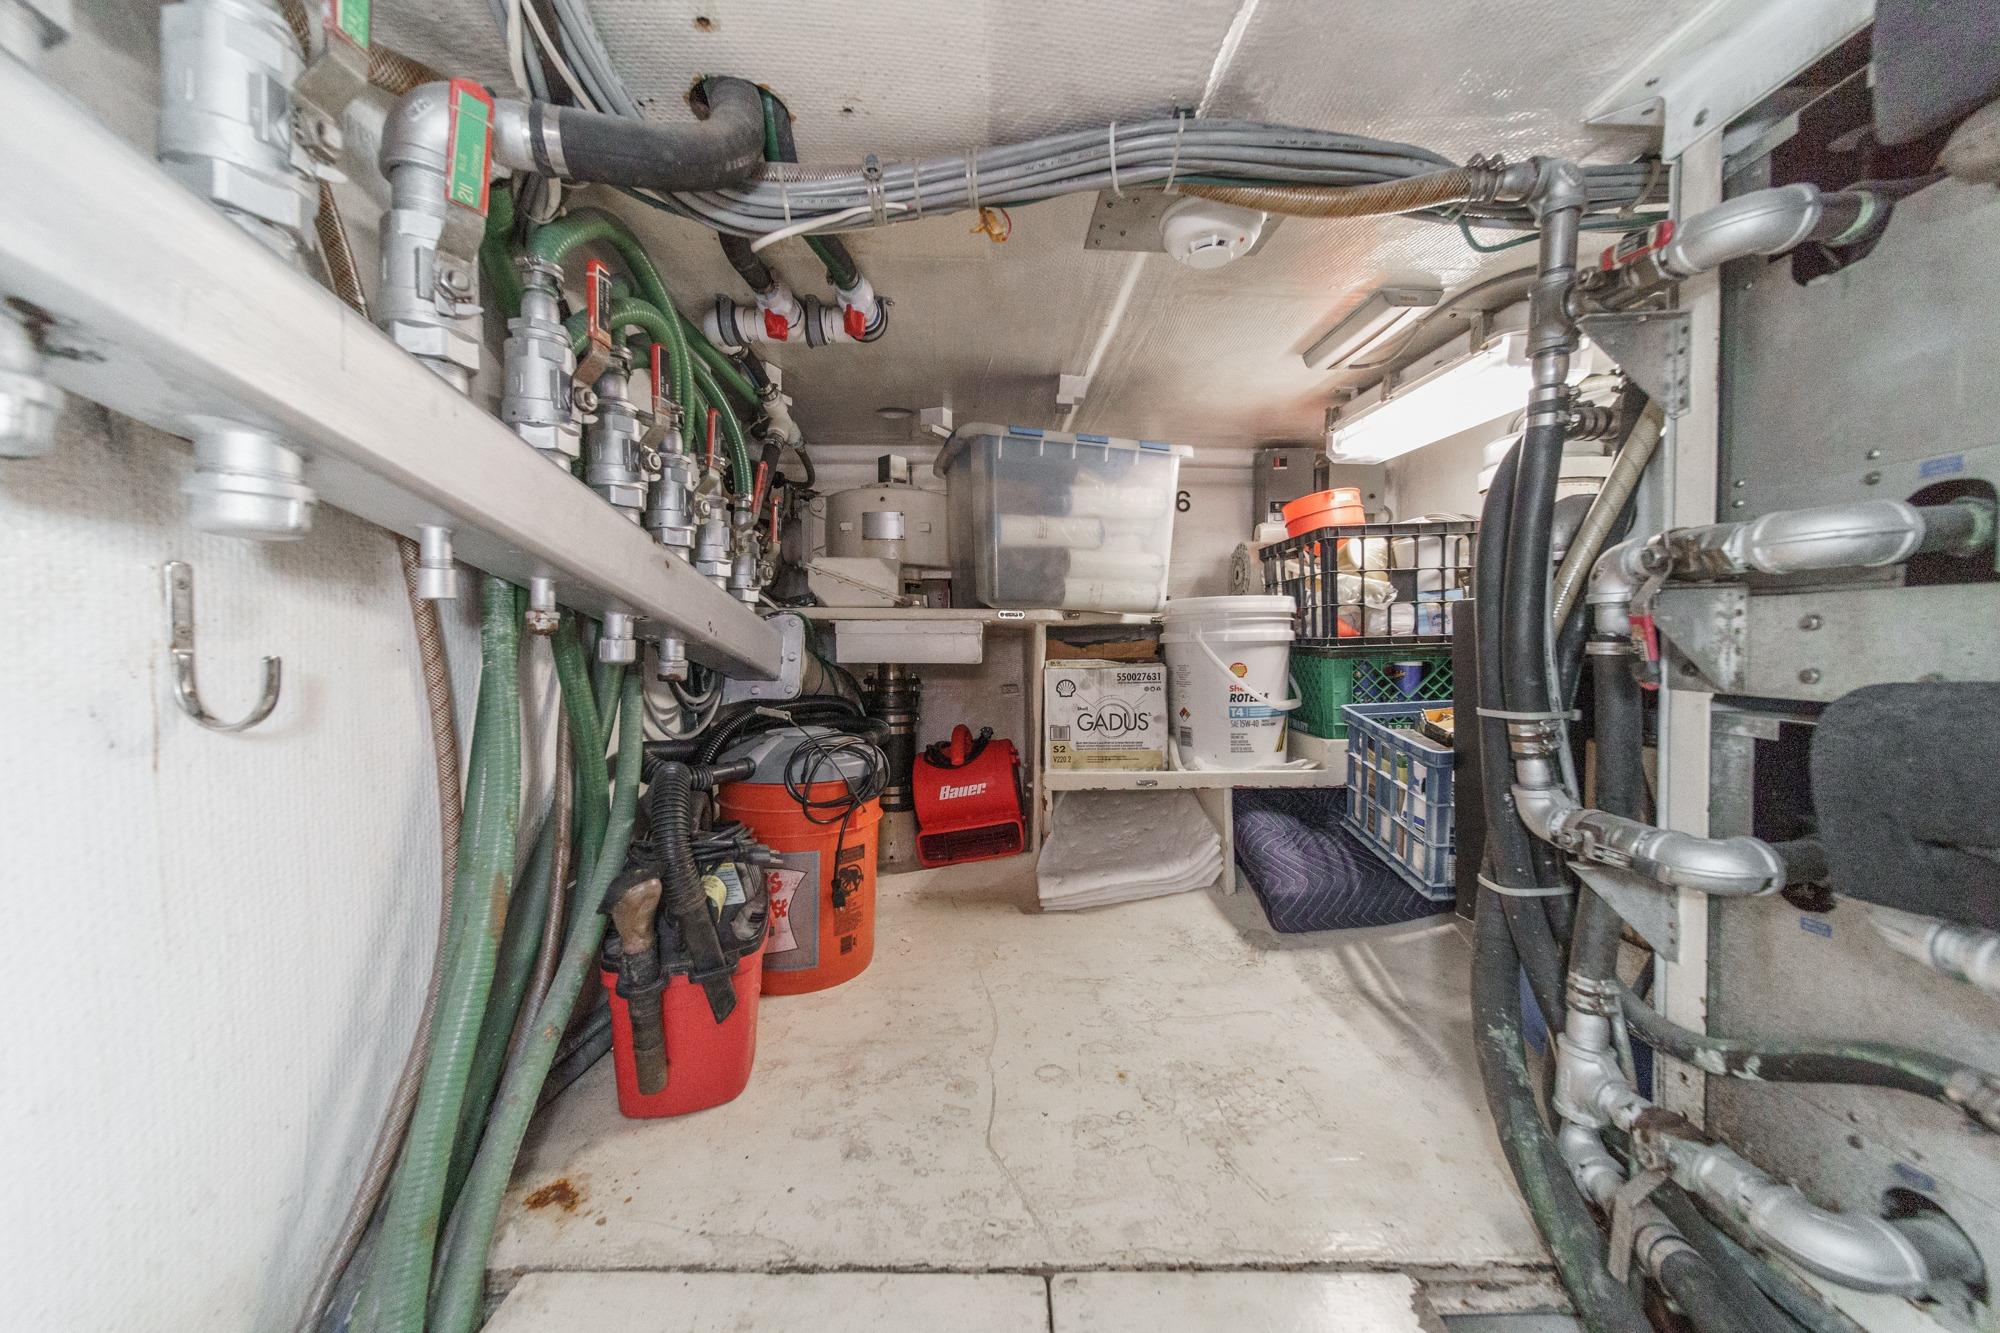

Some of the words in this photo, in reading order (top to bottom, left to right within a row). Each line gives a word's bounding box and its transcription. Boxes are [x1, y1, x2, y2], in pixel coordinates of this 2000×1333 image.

[1176, 490, 1191, 512] 6
[1116, 672, 1161, 681] 550027631
[1230, 707, 1244, 718] T4
[1077, 713, 1149, 731] GADUS
[1053, 745, 1066, 753] S2
[939, 782, 987, 801] Bauer
